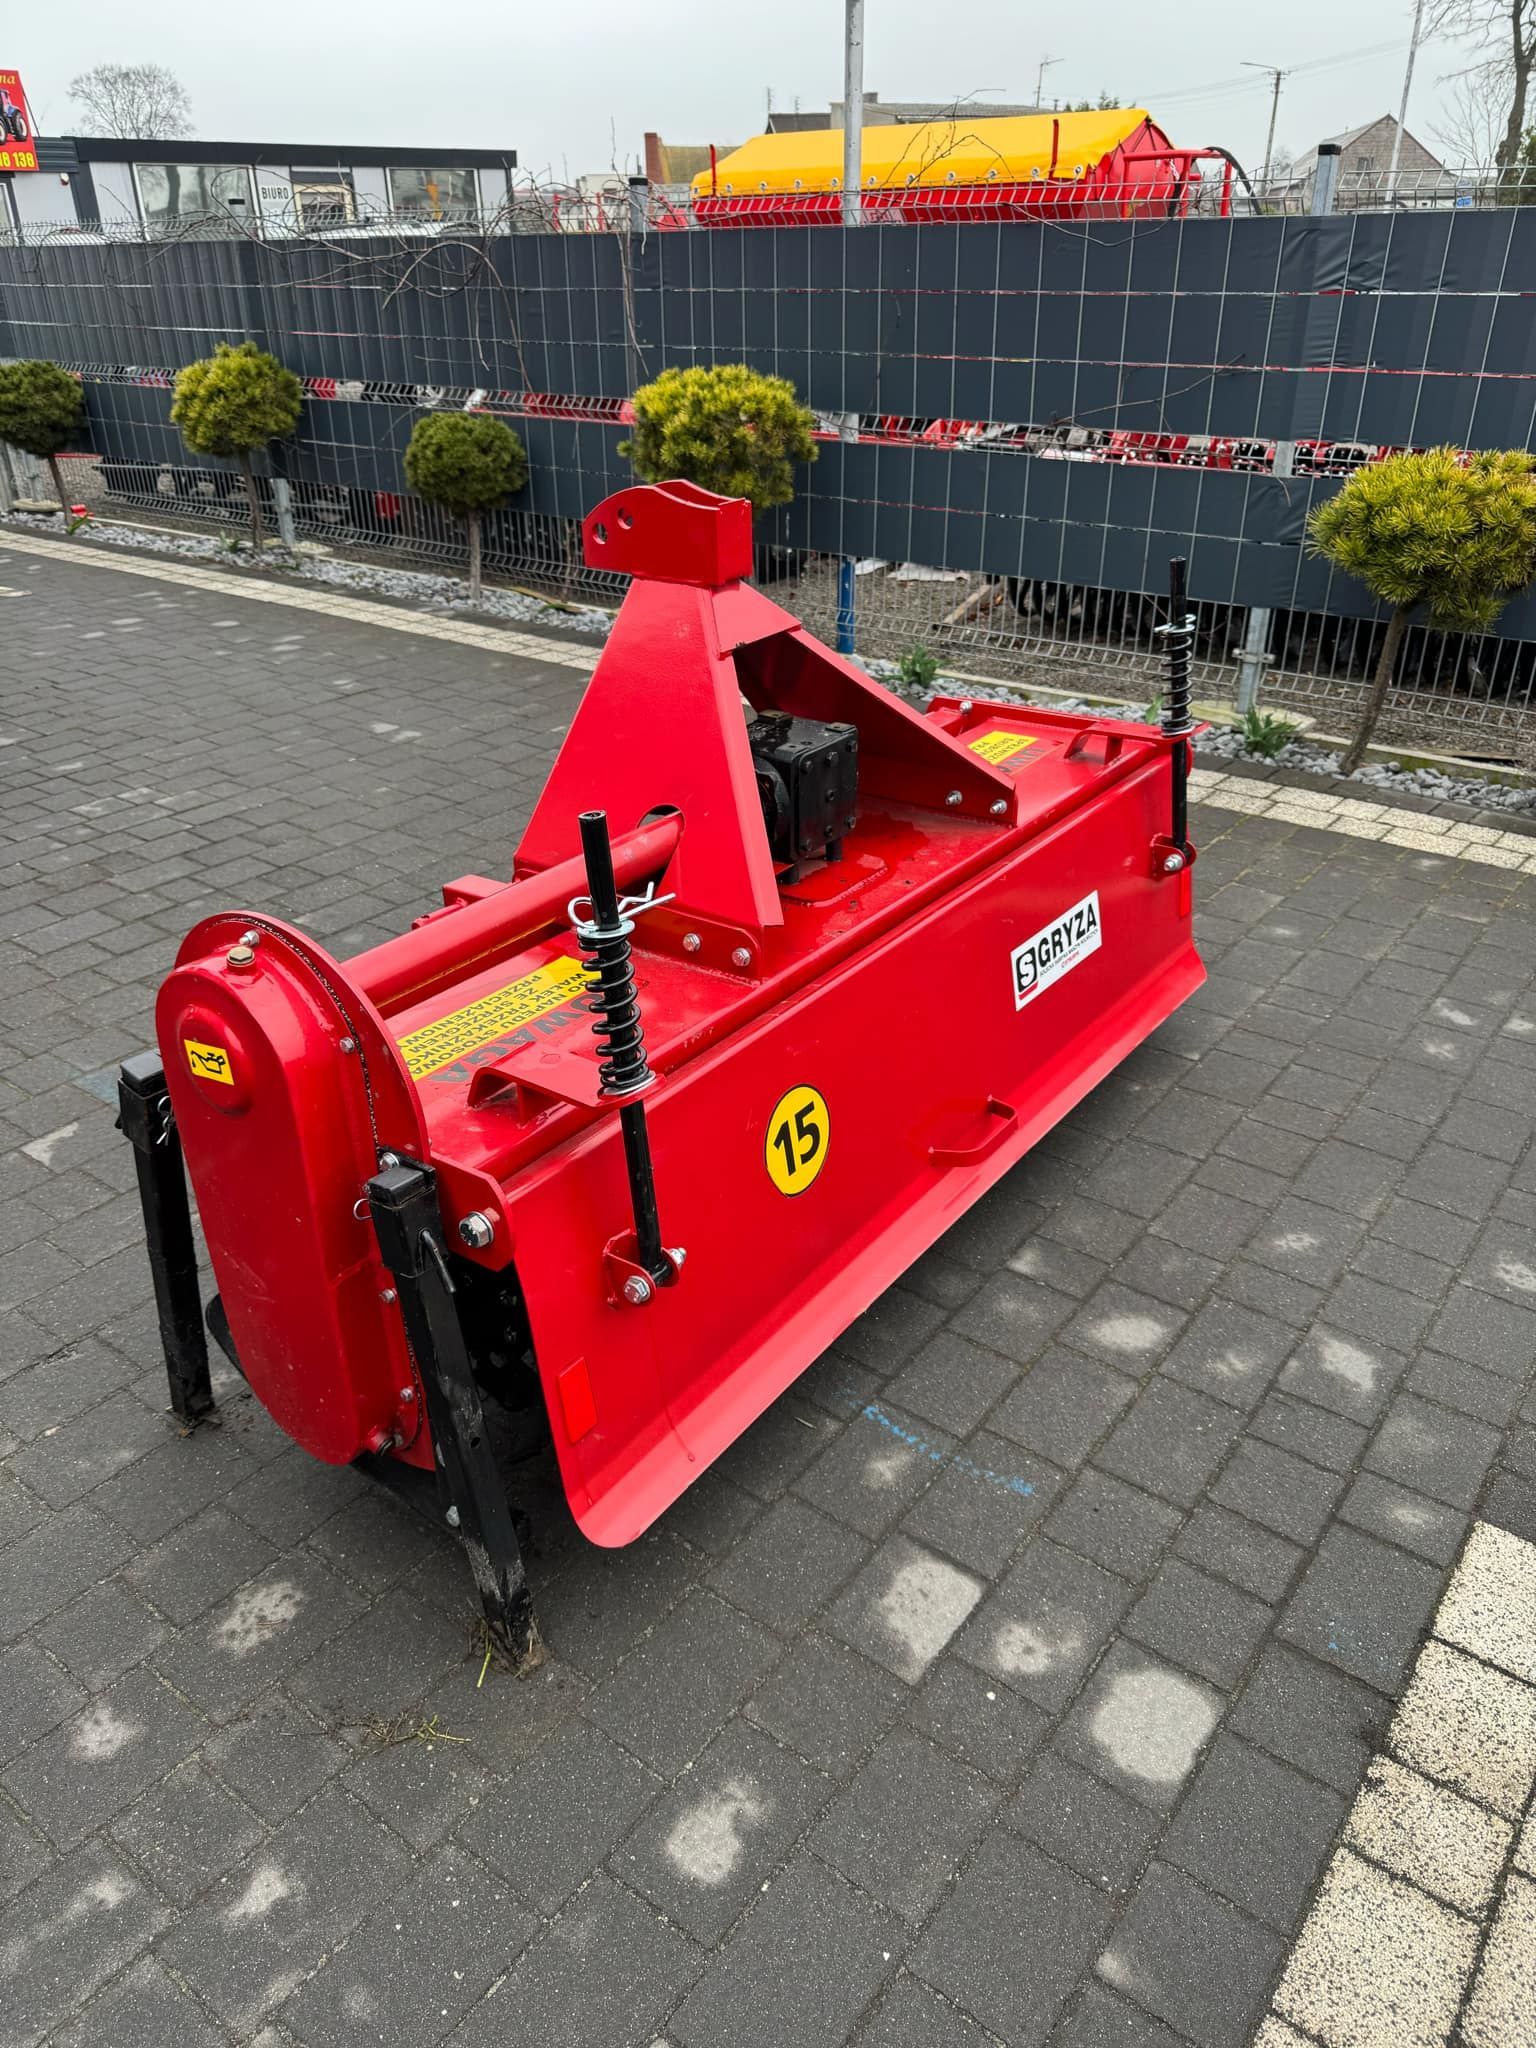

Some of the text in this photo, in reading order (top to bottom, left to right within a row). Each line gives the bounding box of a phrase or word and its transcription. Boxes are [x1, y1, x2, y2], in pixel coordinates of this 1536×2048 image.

[12, 151, 35, 168] 138
[261, 187, 289, 199] BIURO
[1038, 903, 1097, 967] GRYZA
[513, 987, 538, 1000] ZE
[407, 973, 587, 1066] WAŁEK PRZEKAŹNIKO
[411, 1029, 498, 1075] STOSOWA
[773, 1100, 820, 1176] 15
